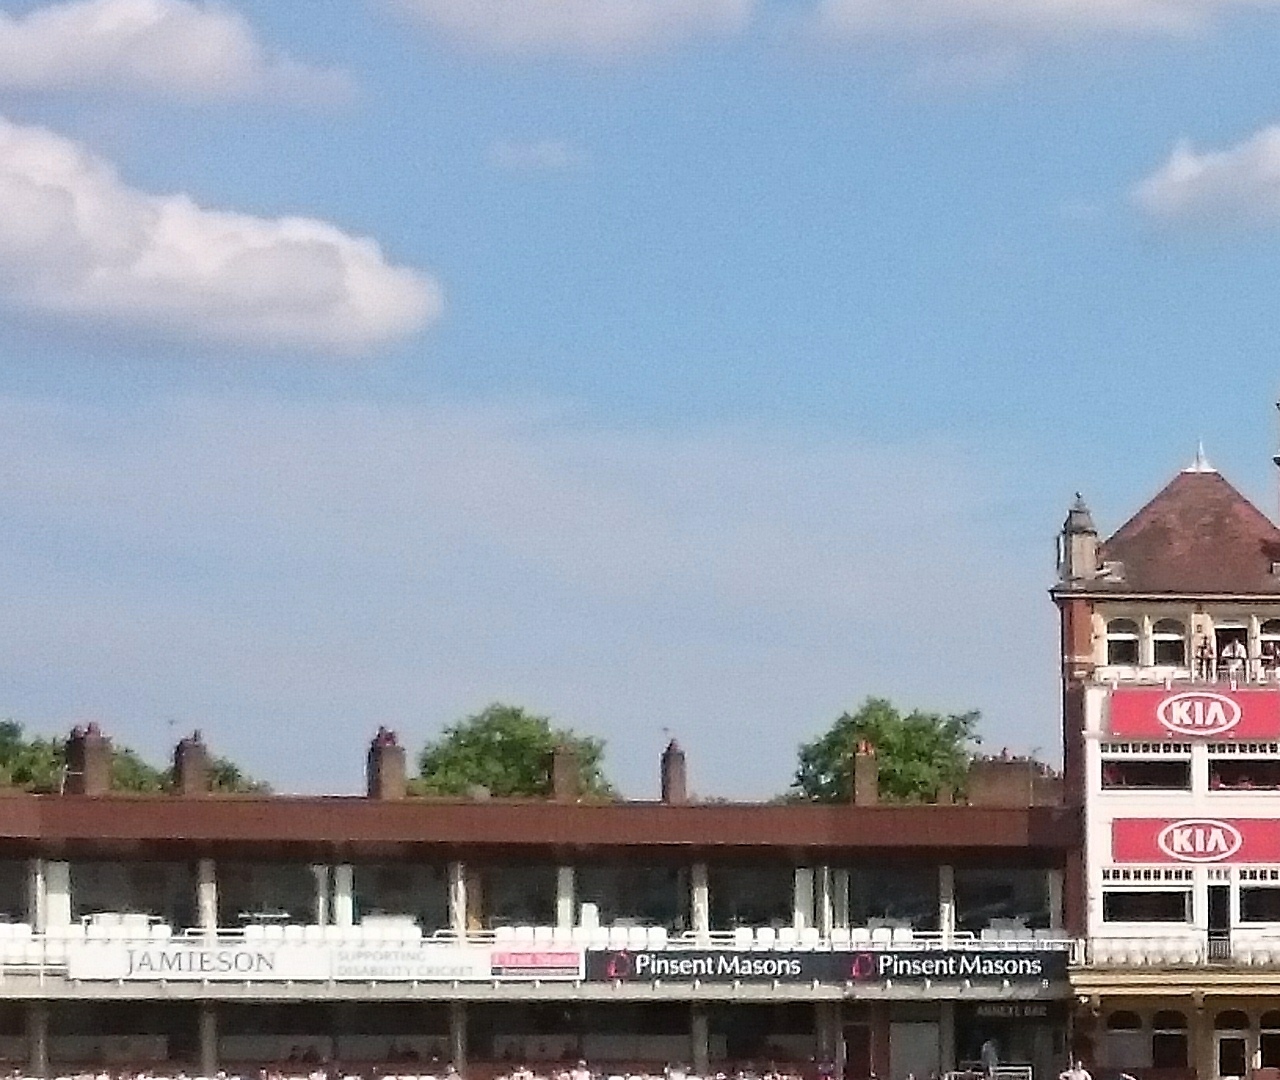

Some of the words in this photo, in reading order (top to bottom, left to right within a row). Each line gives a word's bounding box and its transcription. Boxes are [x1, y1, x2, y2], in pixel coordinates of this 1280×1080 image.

[1171, 701, 1227, 725] KIA
[1172, 828, 1229, 852] KIA
[126, 950, 275, 976] JAMIESON
[635, 955, 713, 975] Pinsent
[718, 955, 801, 975] Masons
[879, 955, 956, 975] Pinsent
[959, 955, 1042, 975] Masons
